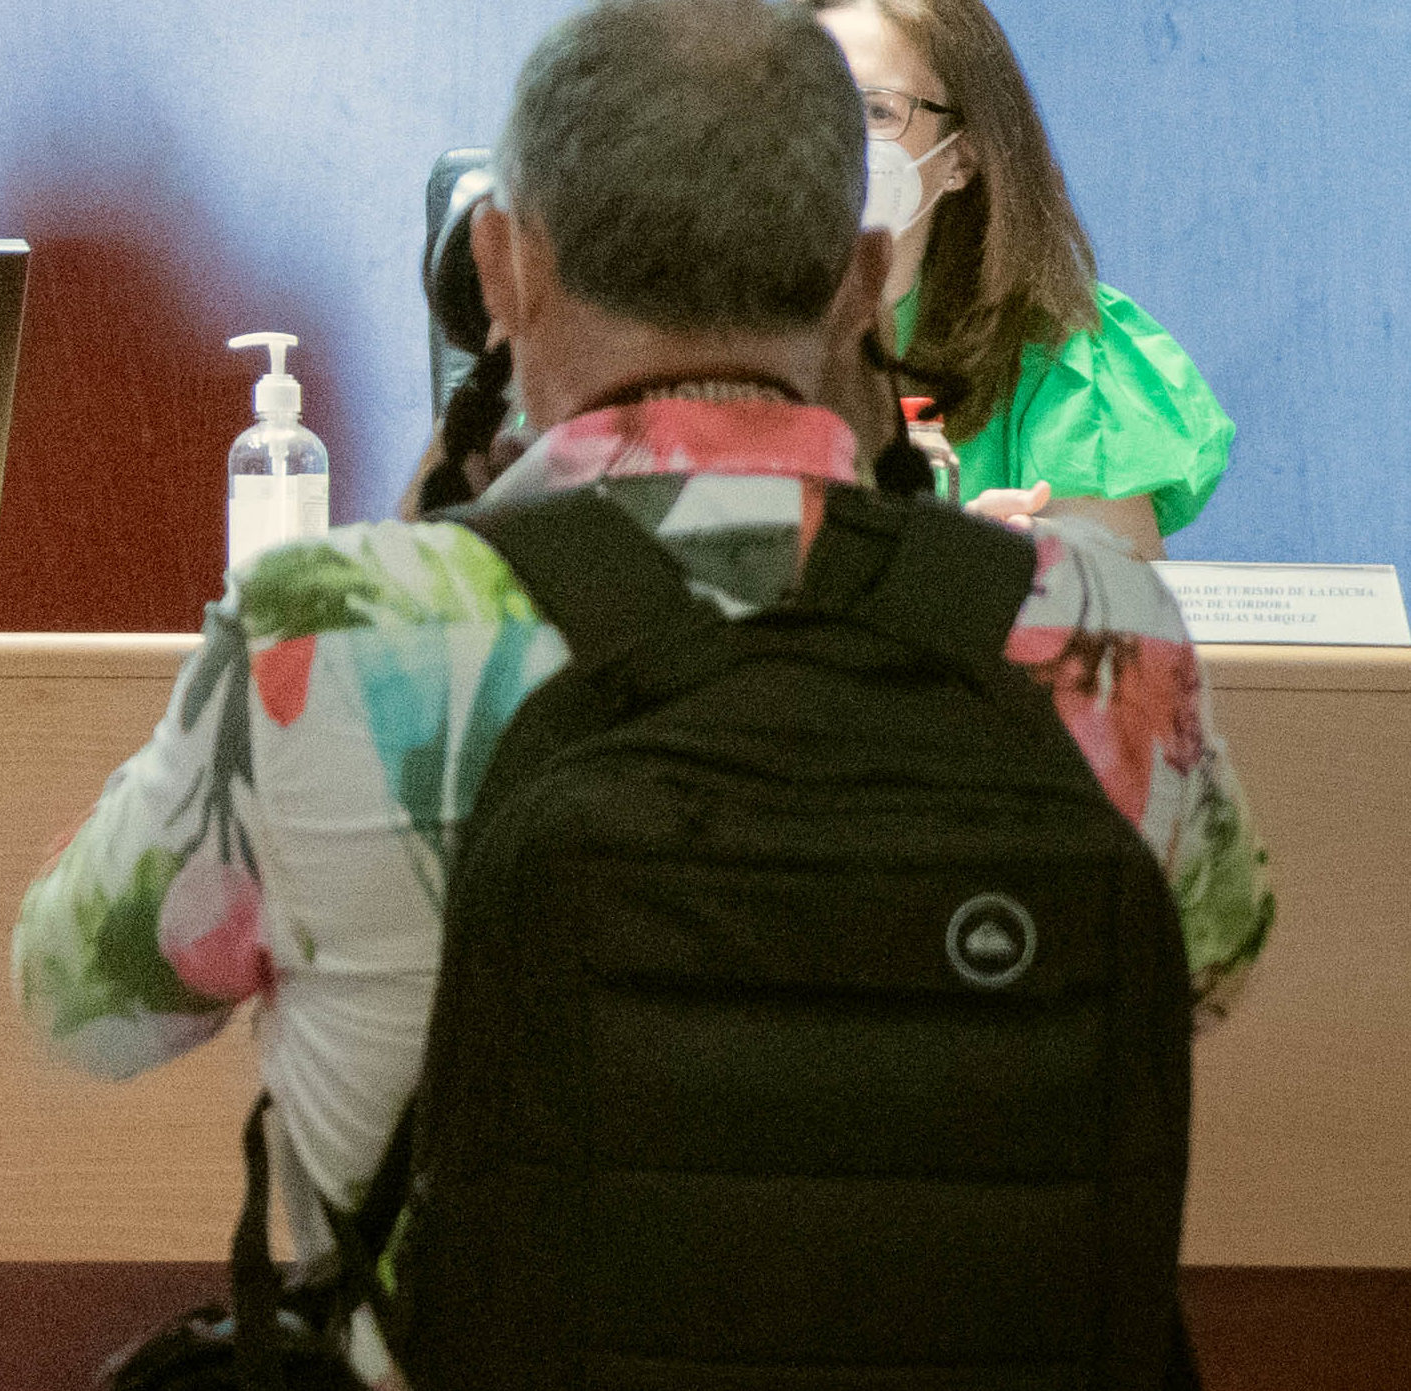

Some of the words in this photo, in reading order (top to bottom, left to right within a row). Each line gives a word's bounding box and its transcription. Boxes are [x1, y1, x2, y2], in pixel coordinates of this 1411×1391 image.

[1203, 585, 1223, 596] DE
[1225, 585, 1285, 597] TURISMO
[1287, 586, 1305, 597] DE
[1308, 587, 1326, 597] LA
[1206, 599, 1225, 610] DE
